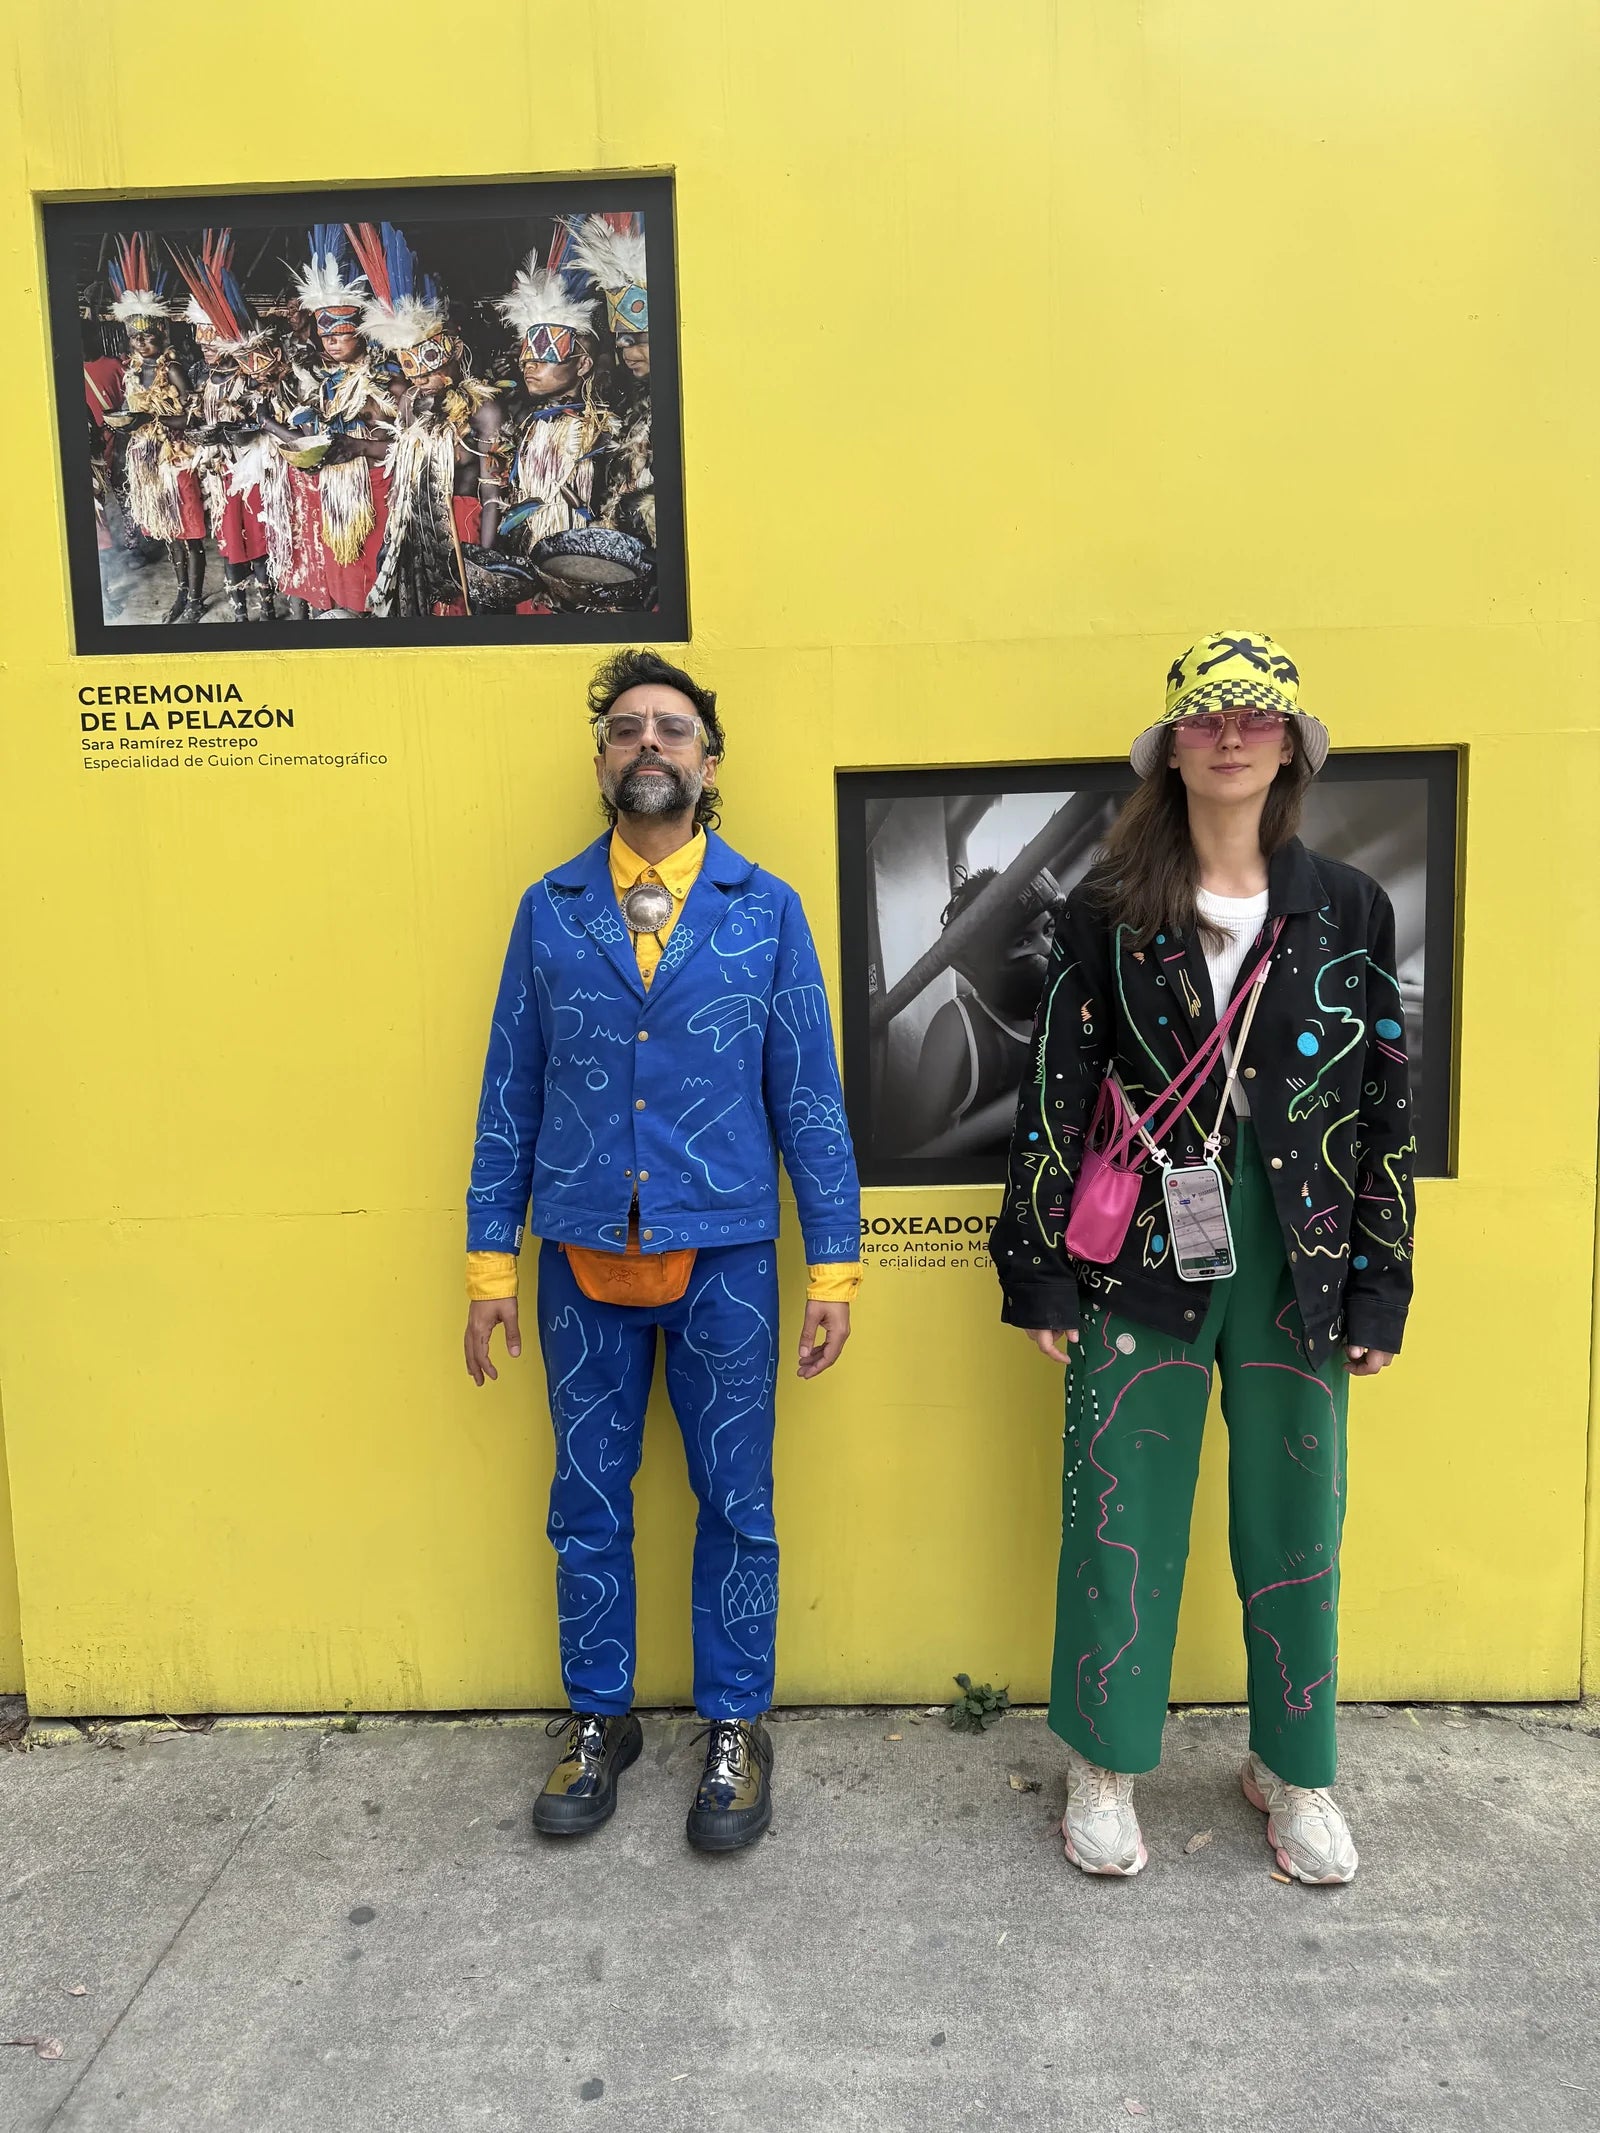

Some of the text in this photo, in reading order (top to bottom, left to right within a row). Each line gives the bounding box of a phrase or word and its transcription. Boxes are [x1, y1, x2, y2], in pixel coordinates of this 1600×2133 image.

[78, 683, 244, 706] CEREMONIA
[80, 704, 295, 732] DE LA PELAZÓN
[81, 736, 259, 751] Sara Ramírez Restrepo
[84, 752, 388, 771] Especialidad de Guion Cinematográfico
[903, 1239, 964, 1253] Antonio
[951, 1258, 969, 1268] en
